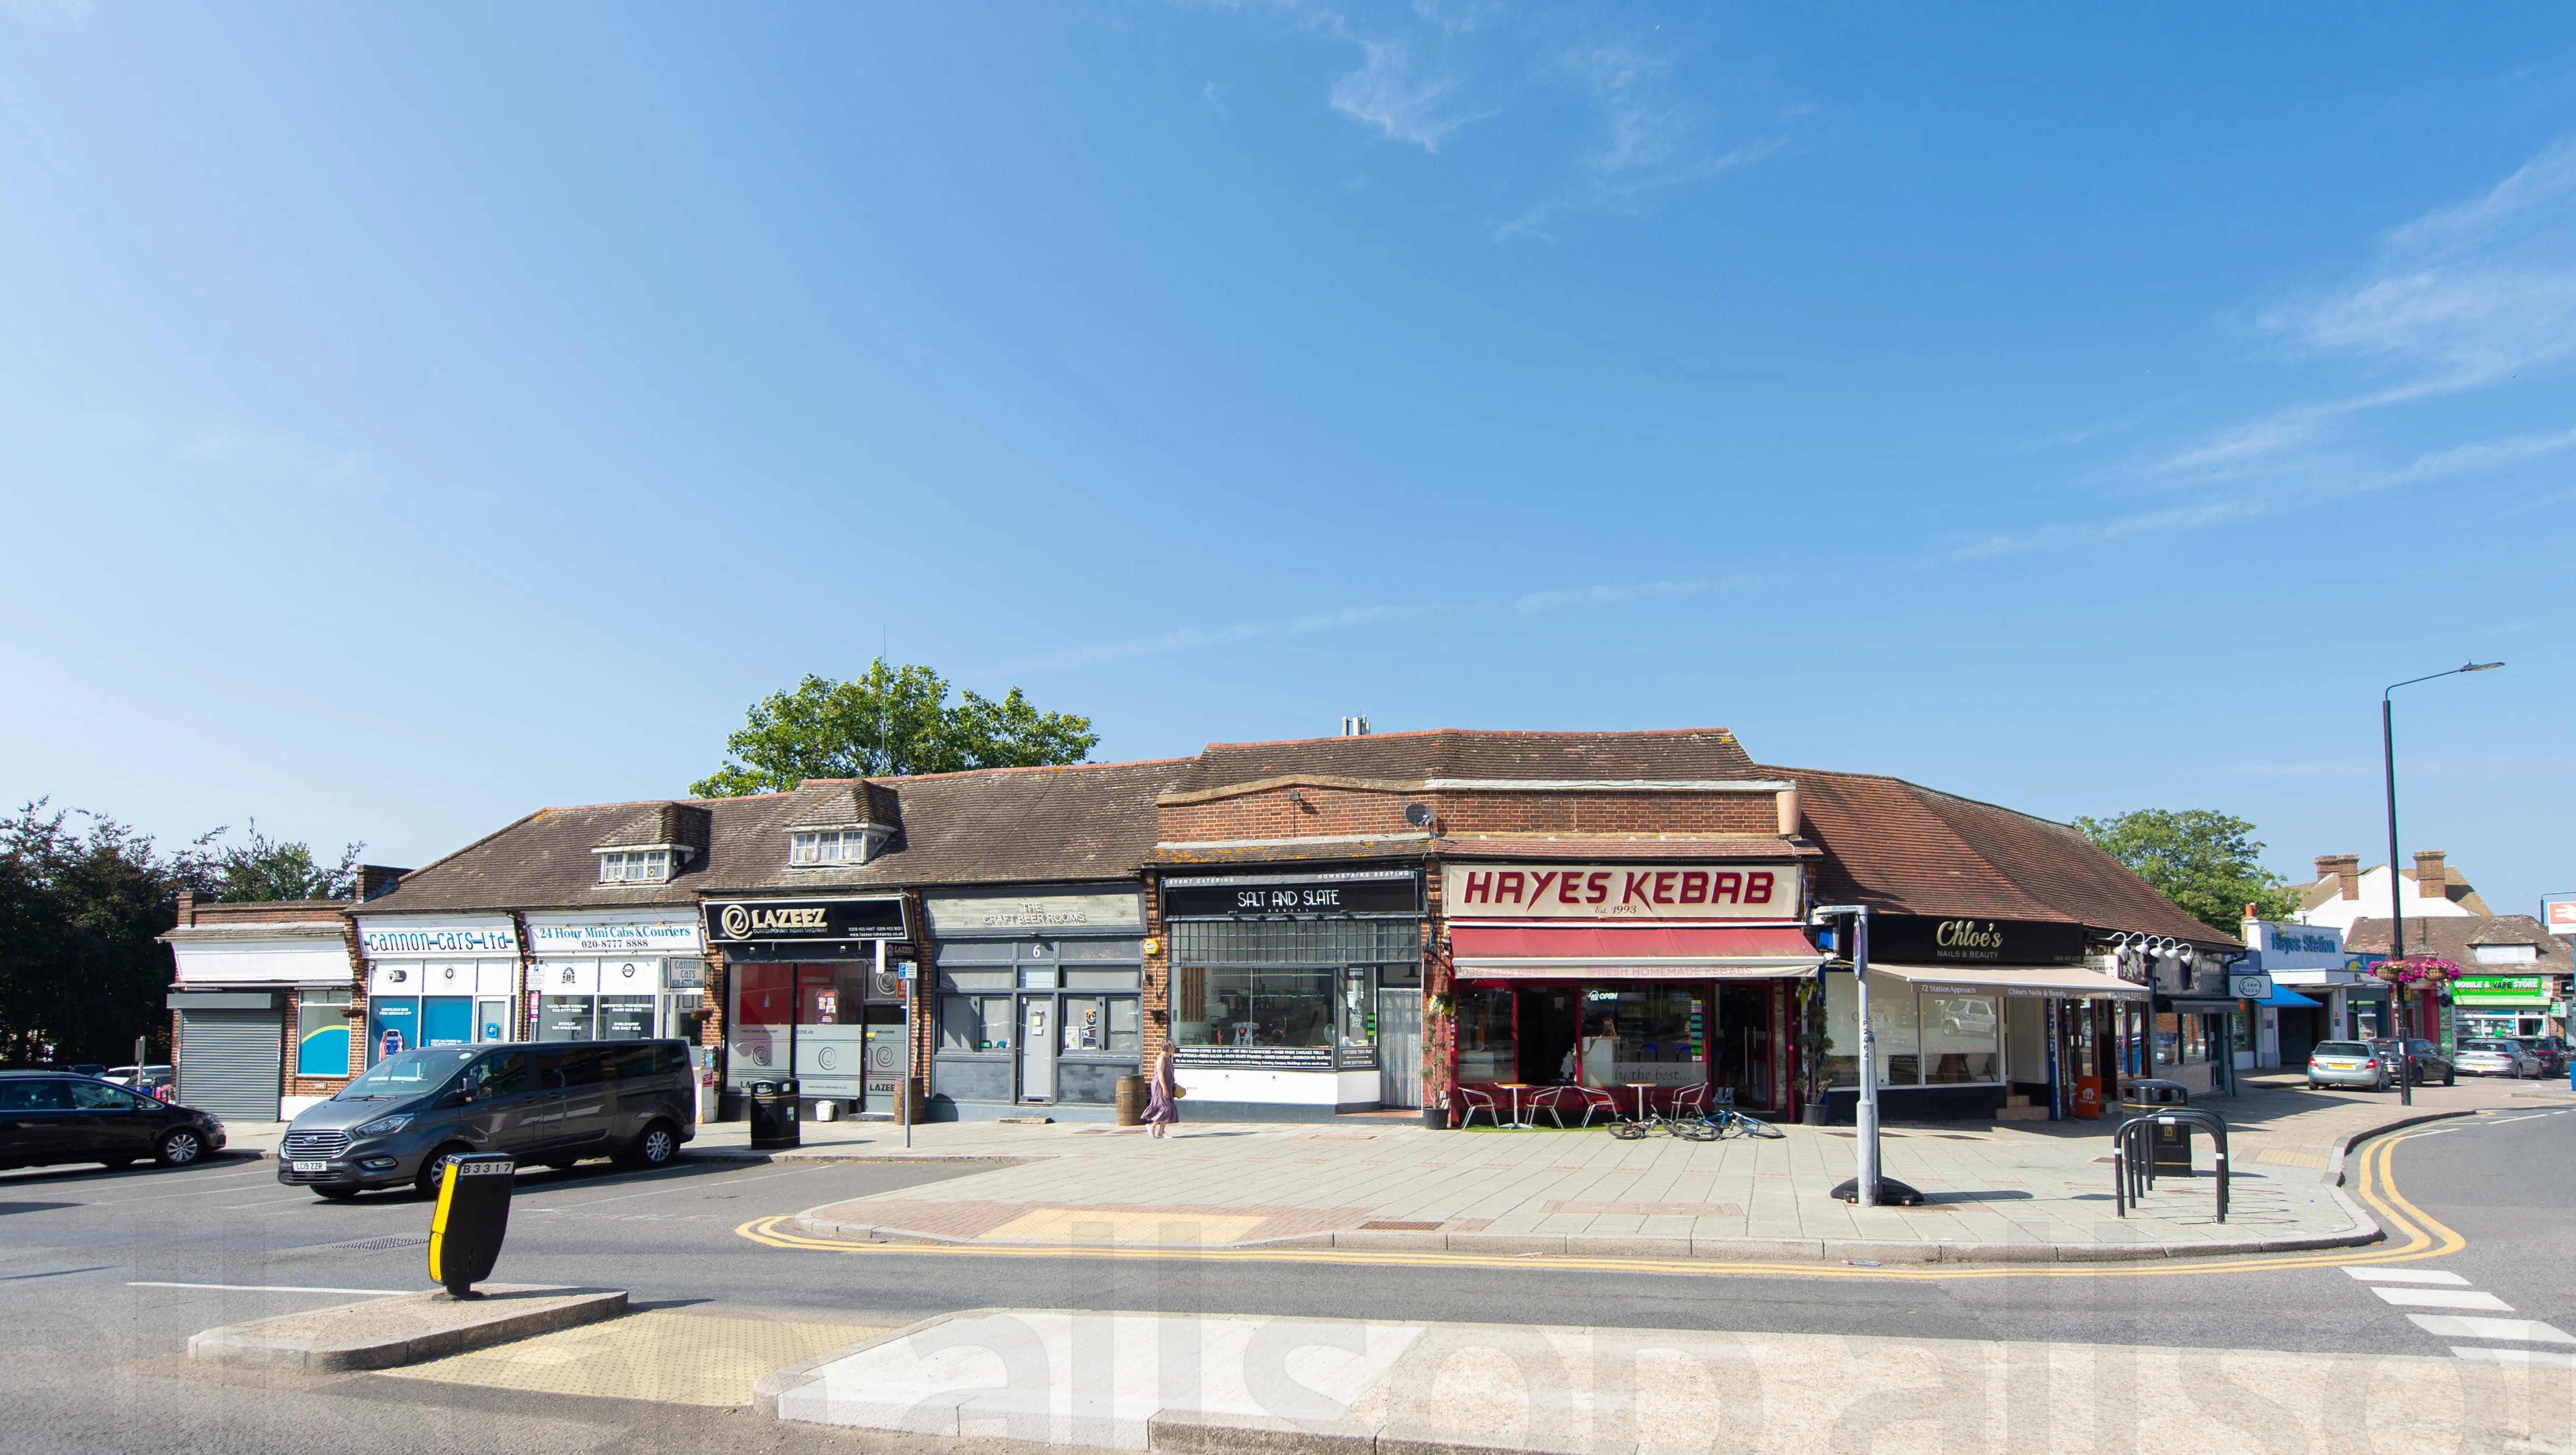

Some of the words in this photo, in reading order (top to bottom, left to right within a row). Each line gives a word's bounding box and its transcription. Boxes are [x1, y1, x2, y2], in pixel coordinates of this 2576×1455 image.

[1238, 892, 1265, 907] SALT
[1272, 891, 1297, 906] AND
[1304, 890, 1340, 905] SLATE
[1464, 872, 1612, 913] HAYES
[1623, 872, 1774, 913] KEBAB
[1021, 902, 1043, 913] THE
[1595, 906, 1608, 914] Est.
[1611, 905, 1637, 914] 1993
[751, 908, 828, 928] LAZEEZ
[983, 914, 1016, 924] CRAFT
[1018, 913, 1046, 923] BEER
[1046, 911, 1085, 923] ROOMS
[540, 928, 552, 939] 24
[554, 928, 582, 939] Hour
[586, 927, 608, 938] Mini
[610, 926, 634, 938] Cabs
[1936, 920, 2003, 948] Chloe's
[581, 939, 622, 948] 020-8777
[626, 939, 648, 947] 8888
[2271, 932, 2302, 954] Hayes
[2303, 935, 2337, 953] Station
[894, 946, 915, 954] LAZEEZ
[1033, 944, 1040, 958] 6
[1487, 968, 1514, 976] 8462
[1591, 967, 1628, 976] FRESH
[1632, 966, 1701, 976] HOMEMADE
[1704, 966, 1753, 975] KEBABS
[1950, 985, 1976, 994] Approach
[1631, 1066, 1650, 1081] the
[869, 1083, 895, 1092] LAZEE
